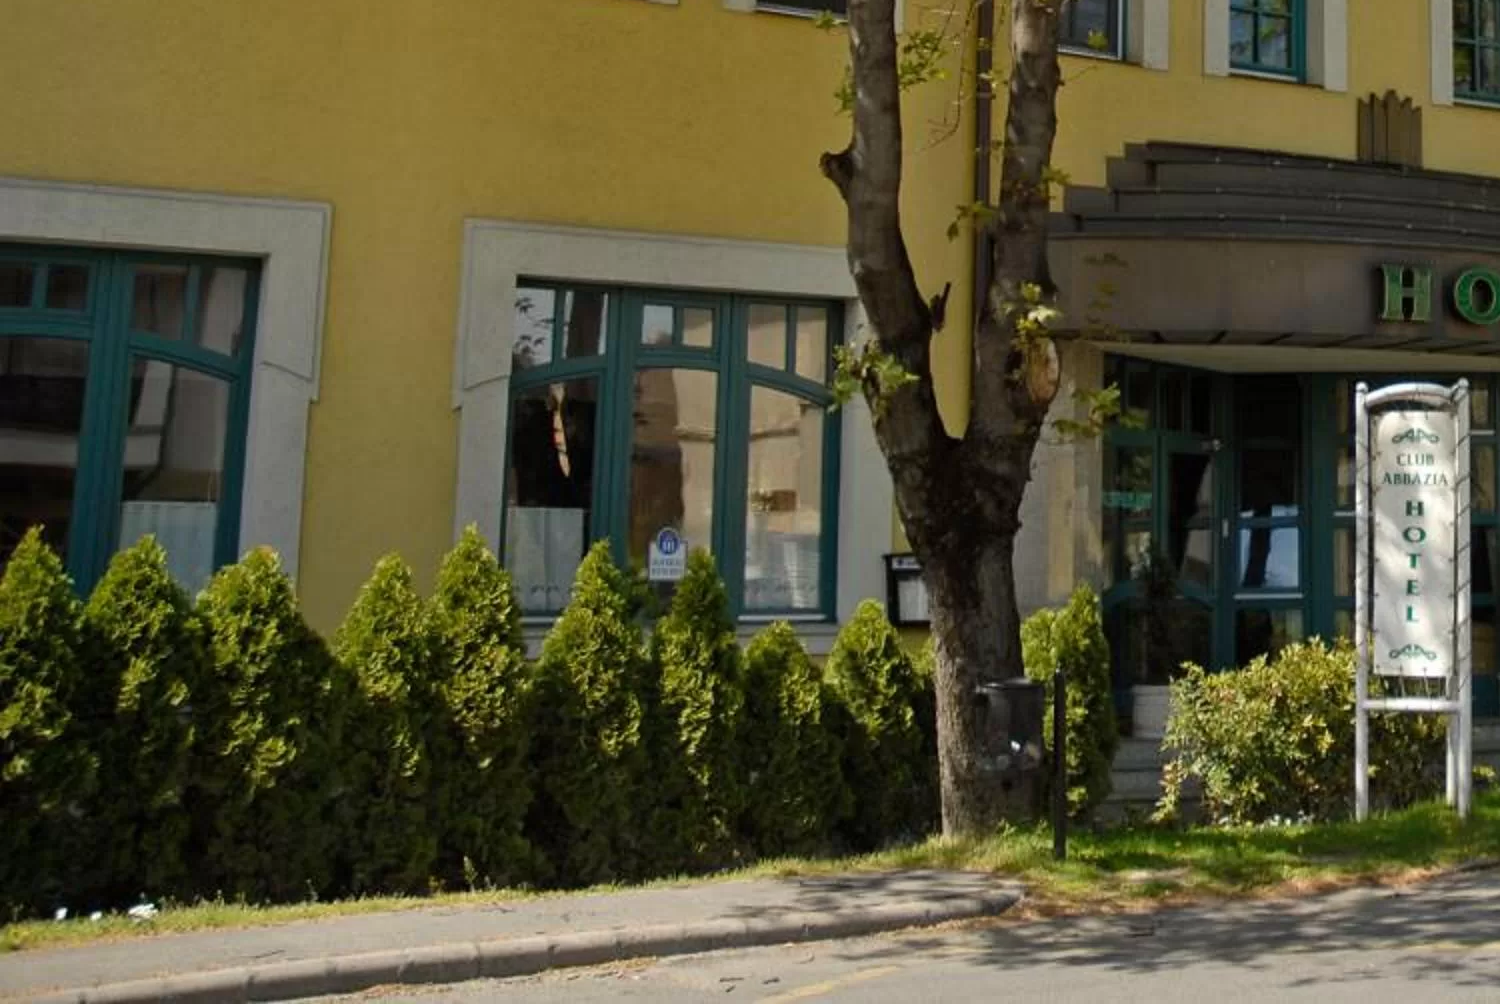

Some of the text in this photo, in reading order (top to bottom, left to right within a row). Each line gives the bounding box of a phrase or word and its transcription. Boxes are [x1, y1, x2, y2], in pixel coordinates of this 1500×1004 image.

[1396, 453, 1434, 466] CLUB
[1382, 471, 1449, 485] ABBAZIA
[1402, 499, 1427, 622] HOTEL
